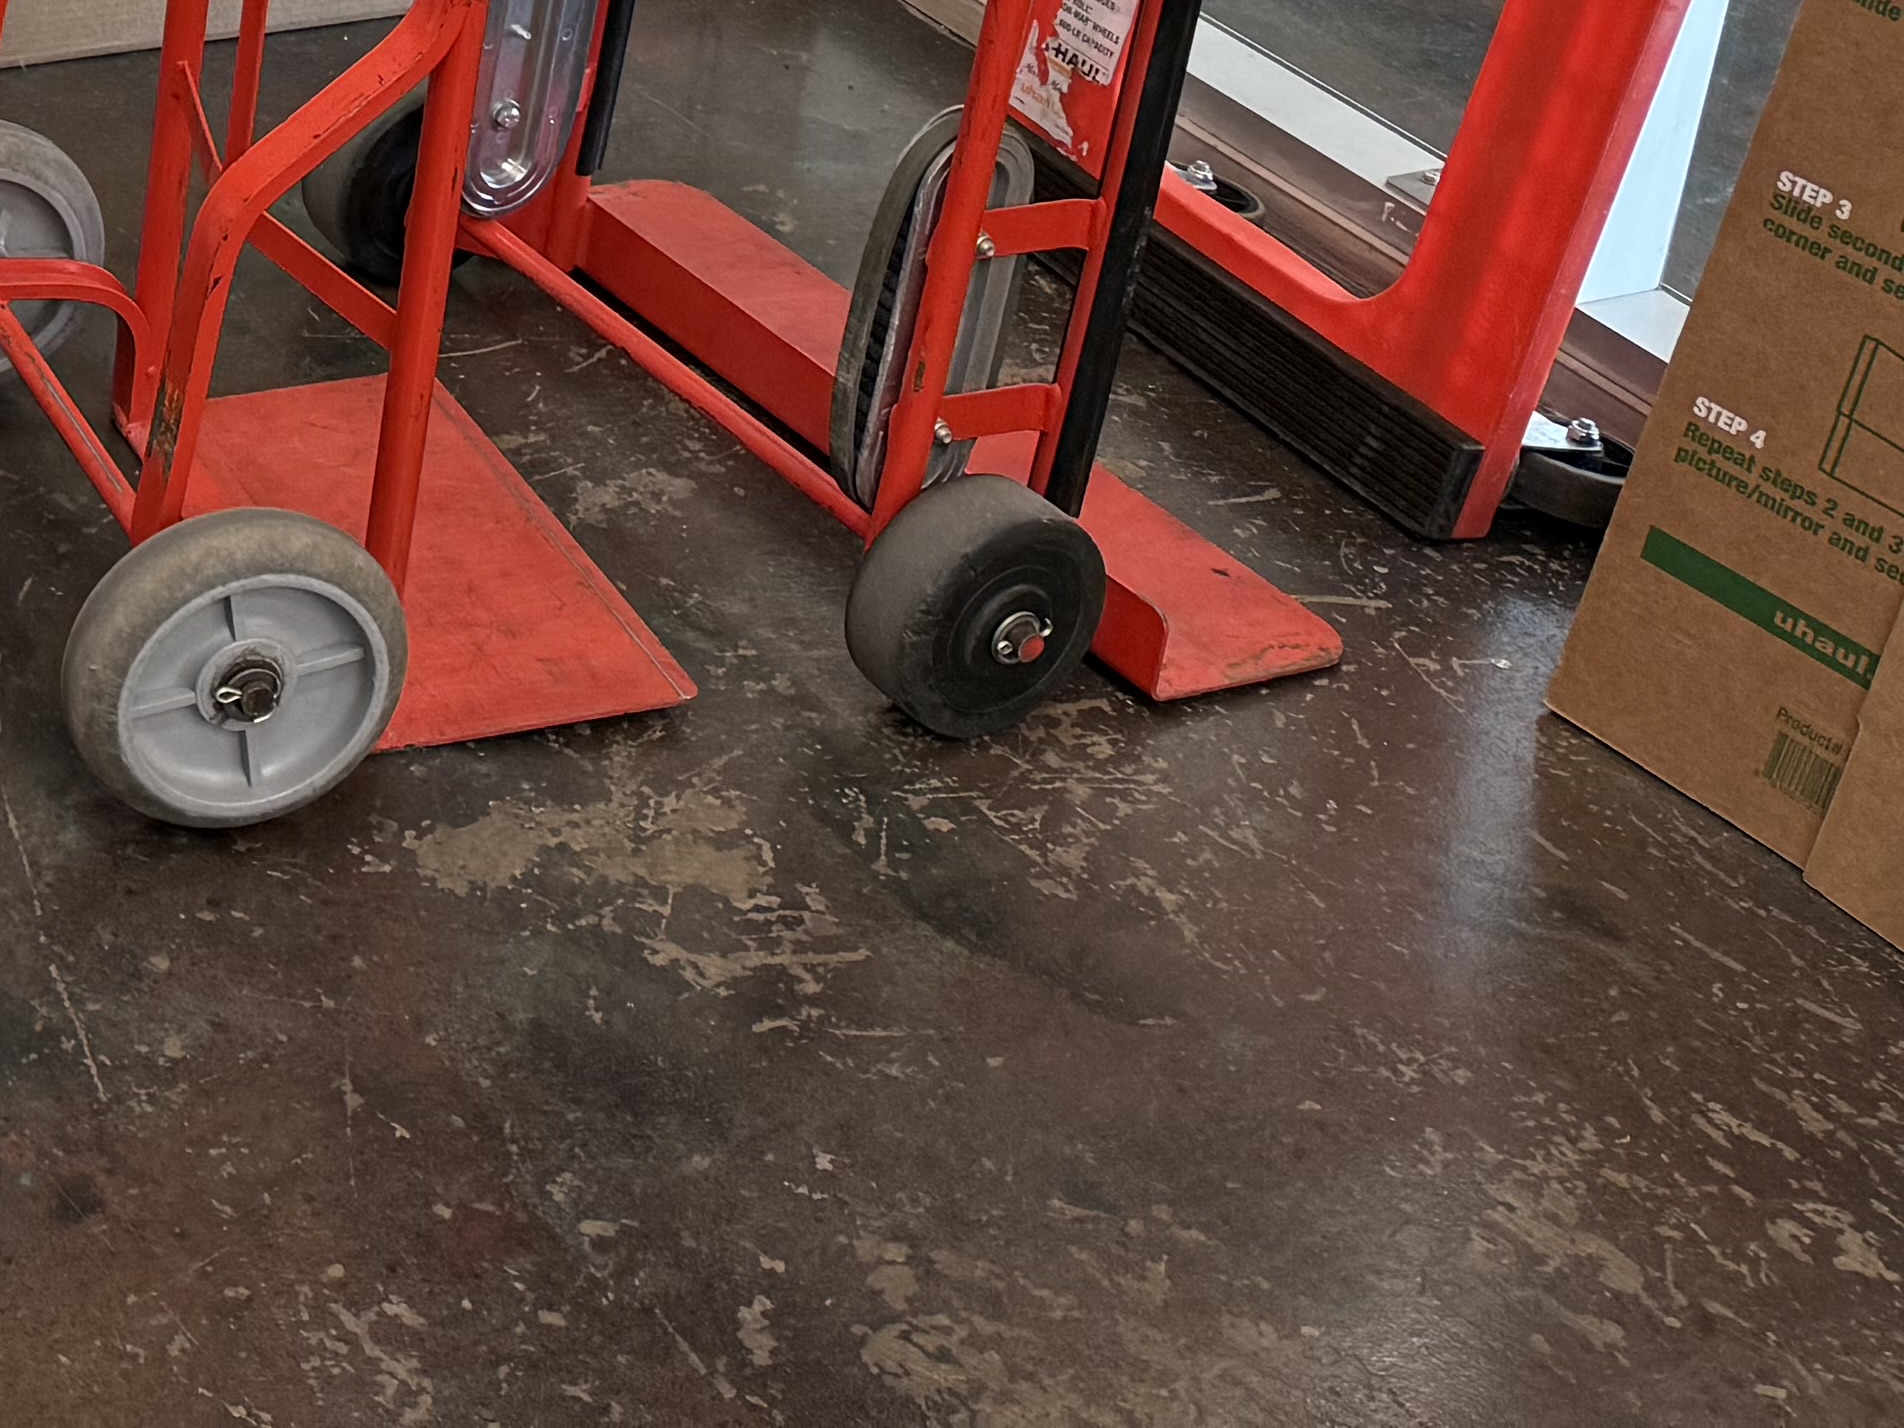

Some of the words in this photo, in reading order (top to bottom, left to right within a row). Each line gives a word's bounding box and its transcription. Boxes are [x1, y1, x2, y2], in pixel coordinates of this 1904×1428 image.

[1692, 396, 1749, 437] STEP
[1750, 430, 1767, 449] 4
[1683, 421, 1756, 474] Repeat
[1759, 462, 1817, 507] steps
[1823, 499, 1837, 518] 2
[1841, 511, 1884, 545] and
